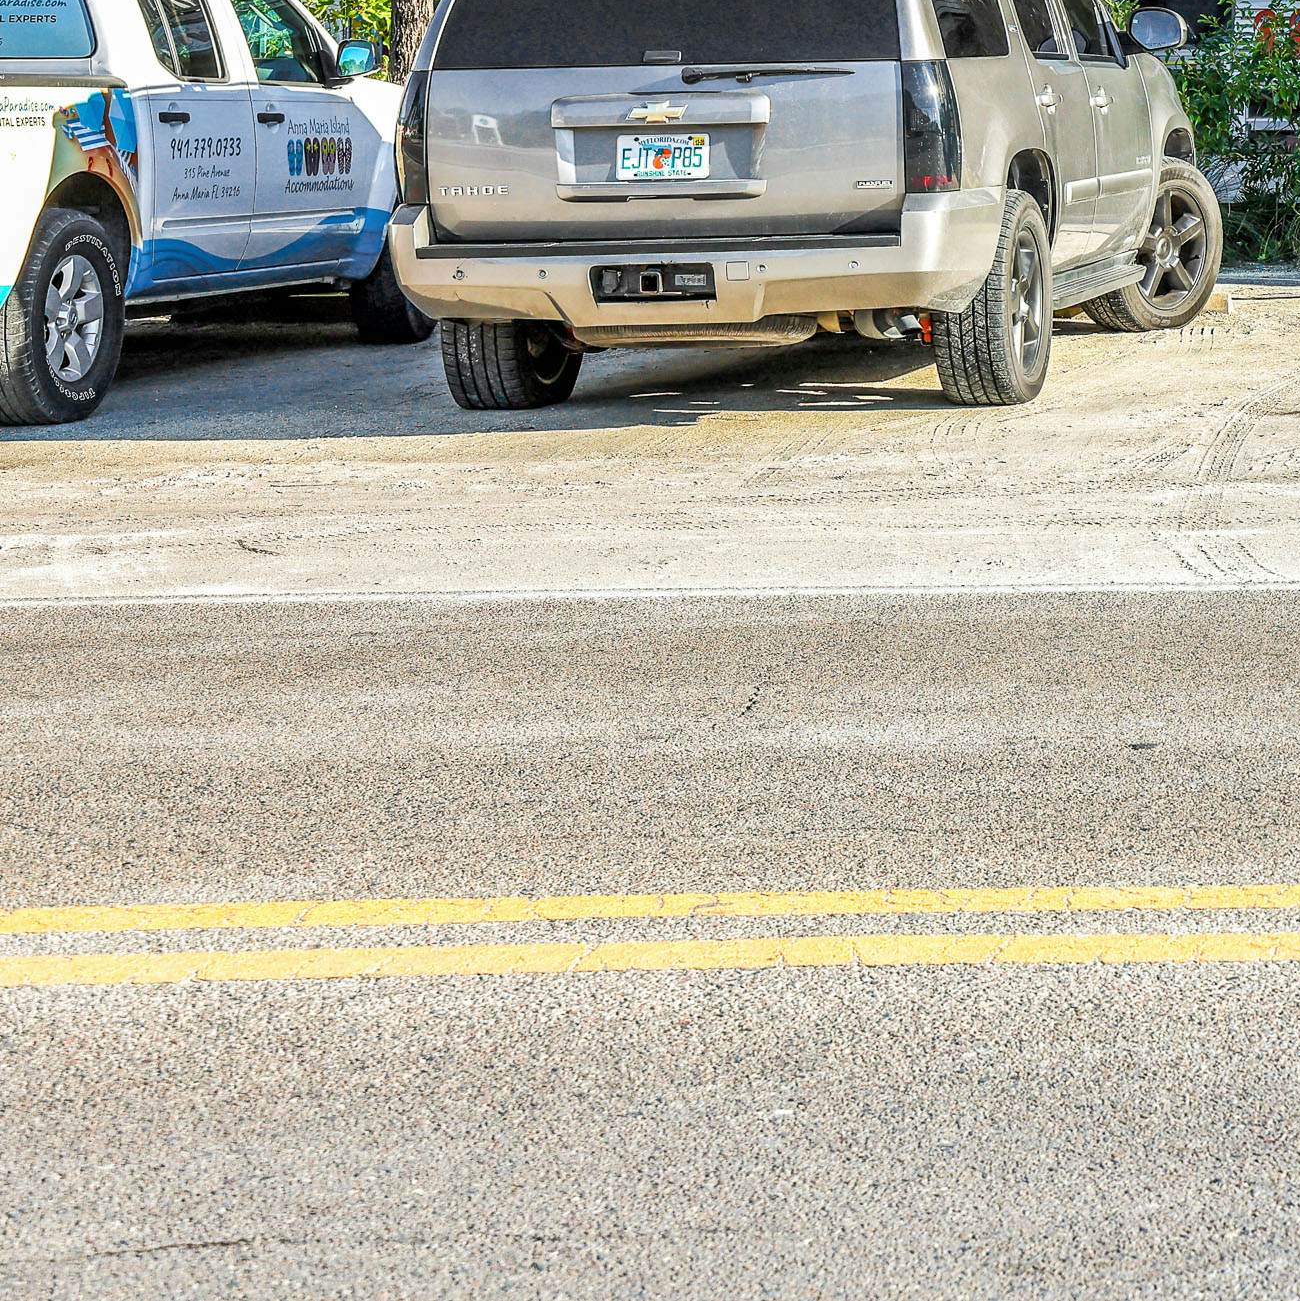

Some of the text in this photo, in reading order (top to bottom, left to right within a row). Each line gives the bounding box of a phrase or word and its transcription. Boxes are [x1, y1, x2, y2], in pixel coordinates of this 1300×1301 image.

[9, 14, 57, 23] EXPERTS
[0, 116, 46, 127] TAL EXPERTS
[287, 115, 350, 136] Anna Maria Island
[170, 137, 241, 160] 941.779.0733
[621, 146, 703, 170] EJT P85
[197, 165, 209, 178] Pine
[668, 169, 687, 177] STATE
[284, 175, 355, 194] Accommodations
[438, 184, 511, 197] TAHOE
[172, 187, 190, 202] Anna
[190, 186, 211, 201] Maria
